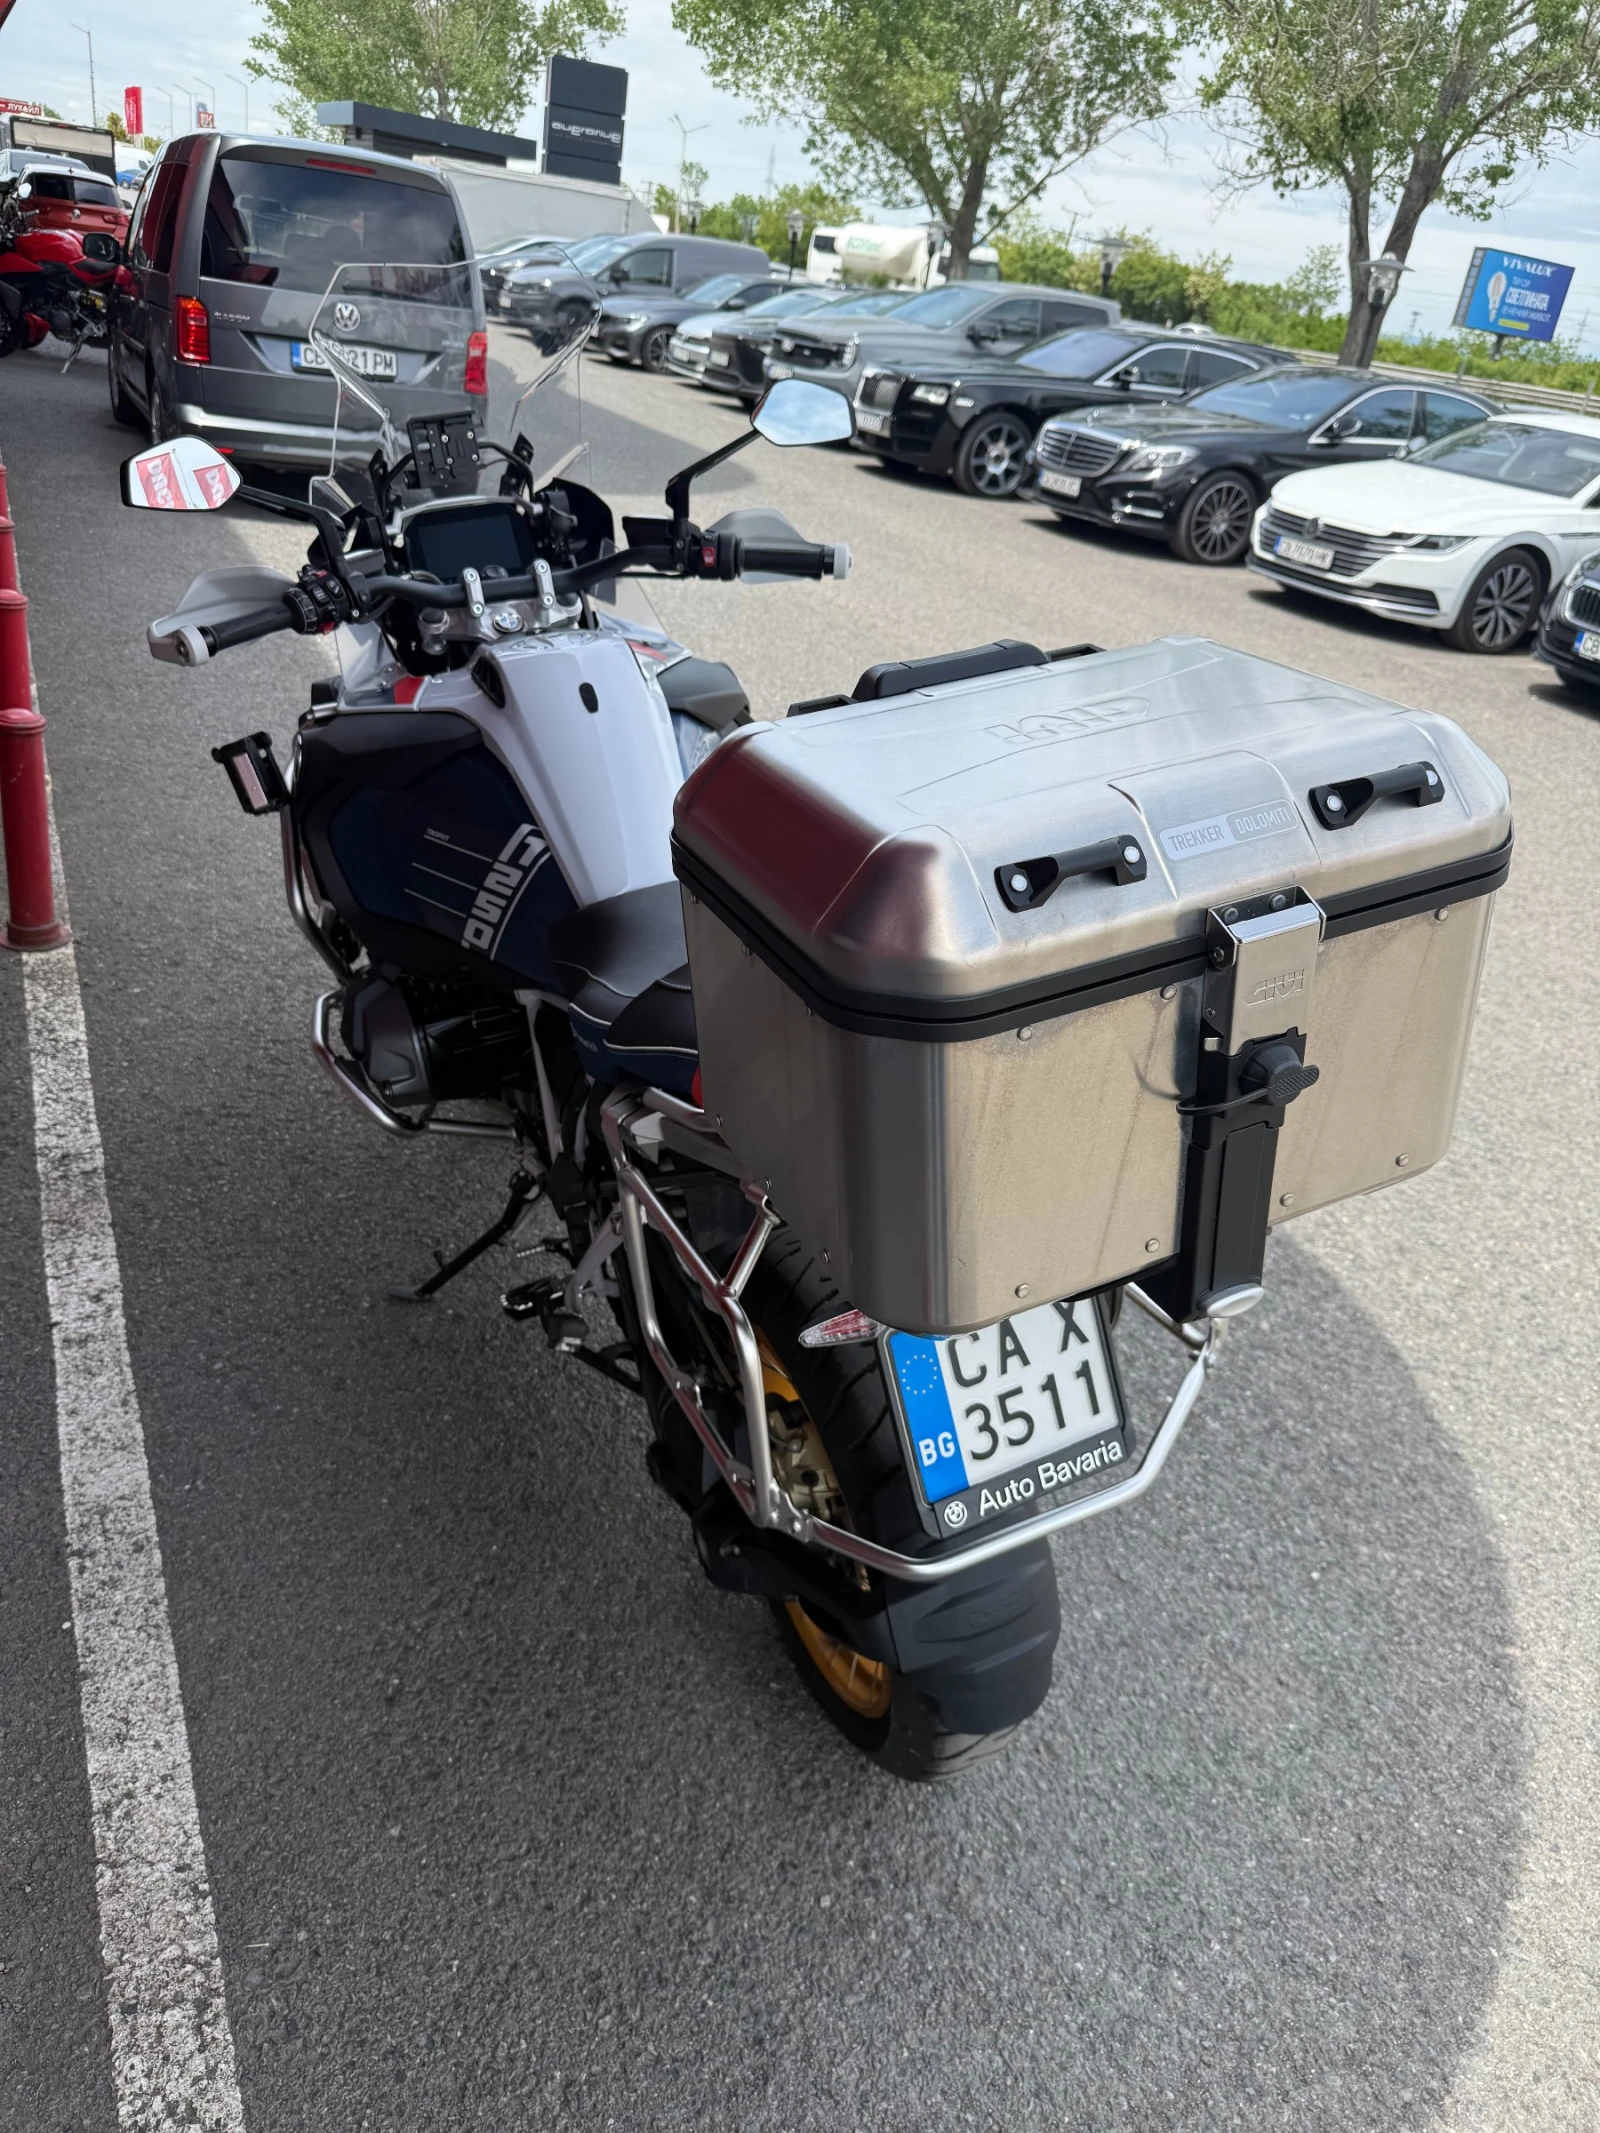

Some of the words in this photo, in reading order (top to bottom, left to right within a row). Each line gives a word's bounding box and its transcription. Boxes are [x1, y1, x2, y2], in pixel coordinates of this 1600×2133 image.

[1503, 257, 1556, 276] VIVALUX
[426, 827, 450, 842] TROPHY
[1168, 824, 1225, 852] TREKKER
[1234, 806, 1291, 835] DOLOMITI
[1244, 969, 1304, 1006] GIVI
[948, 1317, 1031, 1388] CA
[1053, 1300, 1090, 1353] X
[964, 1358, 1101, 1461] 3511
[918, 1431, 956, 1467] BG
[979, 1477, 1035, 1517] Auto
[1037, 1439, 1124, 1490] Bavaria
